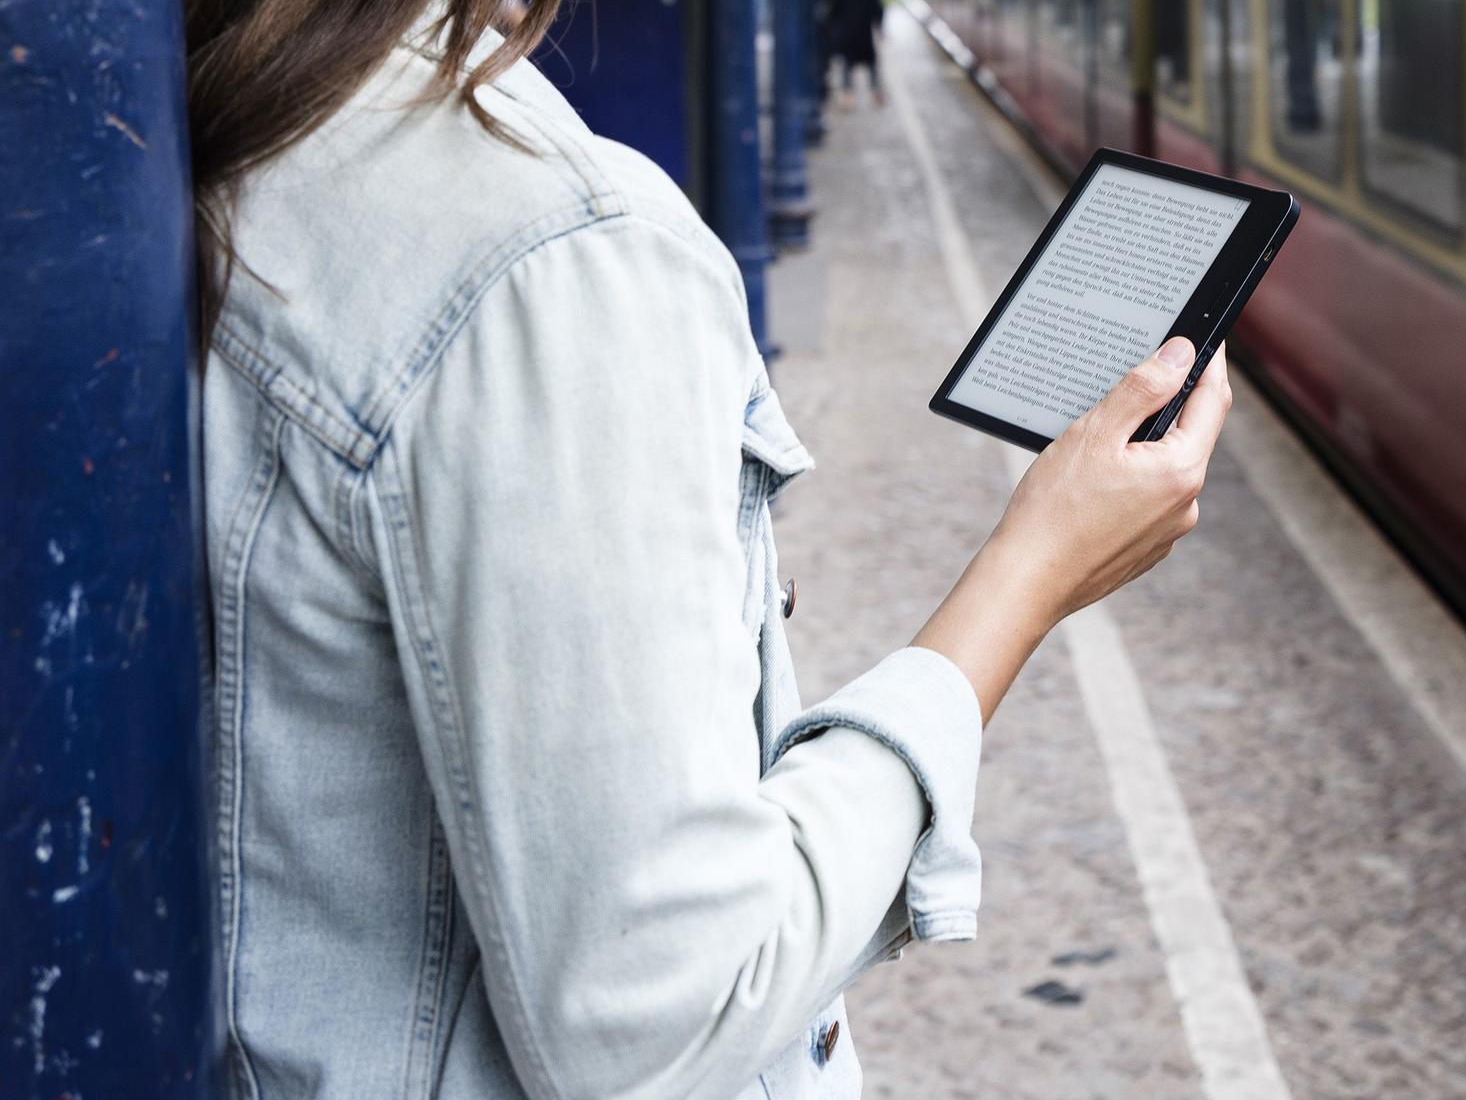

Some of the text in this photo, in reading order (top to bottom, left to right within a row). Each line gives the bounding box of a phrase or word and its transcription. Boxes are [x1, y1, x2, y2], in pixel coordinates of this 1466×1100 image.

[1089, 196, 1107, 206] Leben
[1152, 214, 1166, 223] aber
[1166, 219, 1184, 228] strebt
[1206, 230, 1218, 238] alle
[1095, 188, 1107, 196] Das
[1106, 191, 1124, 200] Leben
[1130, 197, 1140, 205] für
[1196, 215, 1212, 225] denn
[1210, 219, 1222, 228] das
[1114, 184, 1132, 192] regen
[1151, 192, 1167, 201] denn
[1166, 196, 1196, 211] Bewegung
[1195, 204, 1210, 213] liebt
[1078, 214, 1097, 224] Wasser
[1172, 241, 1186, 250] daß
[1192, 247, 1202, 255] ins
[1083, 206, 1118, 220] Bewegungen
[1117, 216, 1143, 227] aufhören
[1181, 233, 1195, 242] läßt
[1202, 239, 1214, 248] das
[1054, 250, 1082, 263] Menschen
[1091, 263, 1112, 273] zwingt
[1110, 267, 1121, 275] ihn
[1058, 243, 1094, 256] grausamsten
[1104, 256, 1148, 272] schrecklichsten
[1146, 269, 1170, 280] verfolgt
[1168, 274, 1179, 282] sie
[1178, 276, 1191, 285] den
[1083, 237, 1093, 245] ins
[1092, 240, 1115, 251] innerste
[1114, 246, 1129, 255] Herz
[1128, 250, 1147, 261] hinein
[1110, 235, 1128, 244] treibt
[1135, 241, 1147, 250] den
[1146, 245, 1160, 254] Saft
[1169, 251, 1182, 260] den
[1035, 279, 1051, 288] gung
[1049, 283, 1074, 294] aufhören
[1042, 270, 1056, 279] rung
[1054, 274, 1073, 282] gegen
[1071, 277, 1083, 286] den
[1082, 281, 1105, 292] Spruch
[1111, 289, 1125, 298] daß
[1133, 296, 1149, 306] Ende
[1148, 302, 1160, 310] alle
[1048, 259, 1059, 267] das
[1088, 272, 1102, 280] aller
[1121, 281, 1133, 290] das
[1138, 288, 1157, 297] steter
[1026, 292, 1036, 300] Vor
[1046, 298, 1063, 309] hinter
[1063, 304, 1077, 313] dem
[1075, 308, 1101, 321] Schlitten
[1100, 318, 1131, 331] wanderten
[1128, 326, 1151, 337] jedoch
[1058, 316, 1099, 332] unerschrocken
[1098, 327, 1108, 336] die
[1107, 330, 1128, 342] beiden
[1008, 320, 1020, 328] Pelz
[1029, 329, 1072, 346] weichgegerbtes
[1071, 341, 1089, 352] Leder
[1109, 354, 1123, 364] Ihre
[1014, 310, 1024, 318] die
[1036, 317, 1060, 332] lebendig
[1078, 332, 1089, 340] Ihr
[1087, 335, 1108, 347] Körper
[1125, 347, 1145, 360] dicken
[1025, 337, 1048, 350] Wangen
[1047, 346, 1061, 354] und
[1058, 349, 1079, 360] Lippen
[1078, 357, 1097, 366] waren
[994, 361, 1010, 371] ihnen
[1009, 366, 1020, 375] das
[1019, 370, 1046, 384] Aussehen
[1054, 384, 1098, 403] gespenstischen
[1004, 341, 1017, 350] den
[1015, 345, 1049, 362] Eiskristallen
[1048, 356, 1064, 367] ihres
[1061, 363, 1094, 377] gefrorenen
[1092, 372, 1112, 384] Atems
[1011, 355, 1025, 364] daß
[1022, 359, 1033, 368] die
[1031, 362, 1068, 381] Gesichtszüge
[1066, 377, 1102, 392] unkenntlich
[971, 376, 1060, 413] Welt beim Leichenbegängnis eines
[977, 366, 988, 375] ken
[1010, 378, 1051, 398] Leichenträgern
[1050, 394, 1062, 402] aus
[1060, 398, 1076, 407] einer
